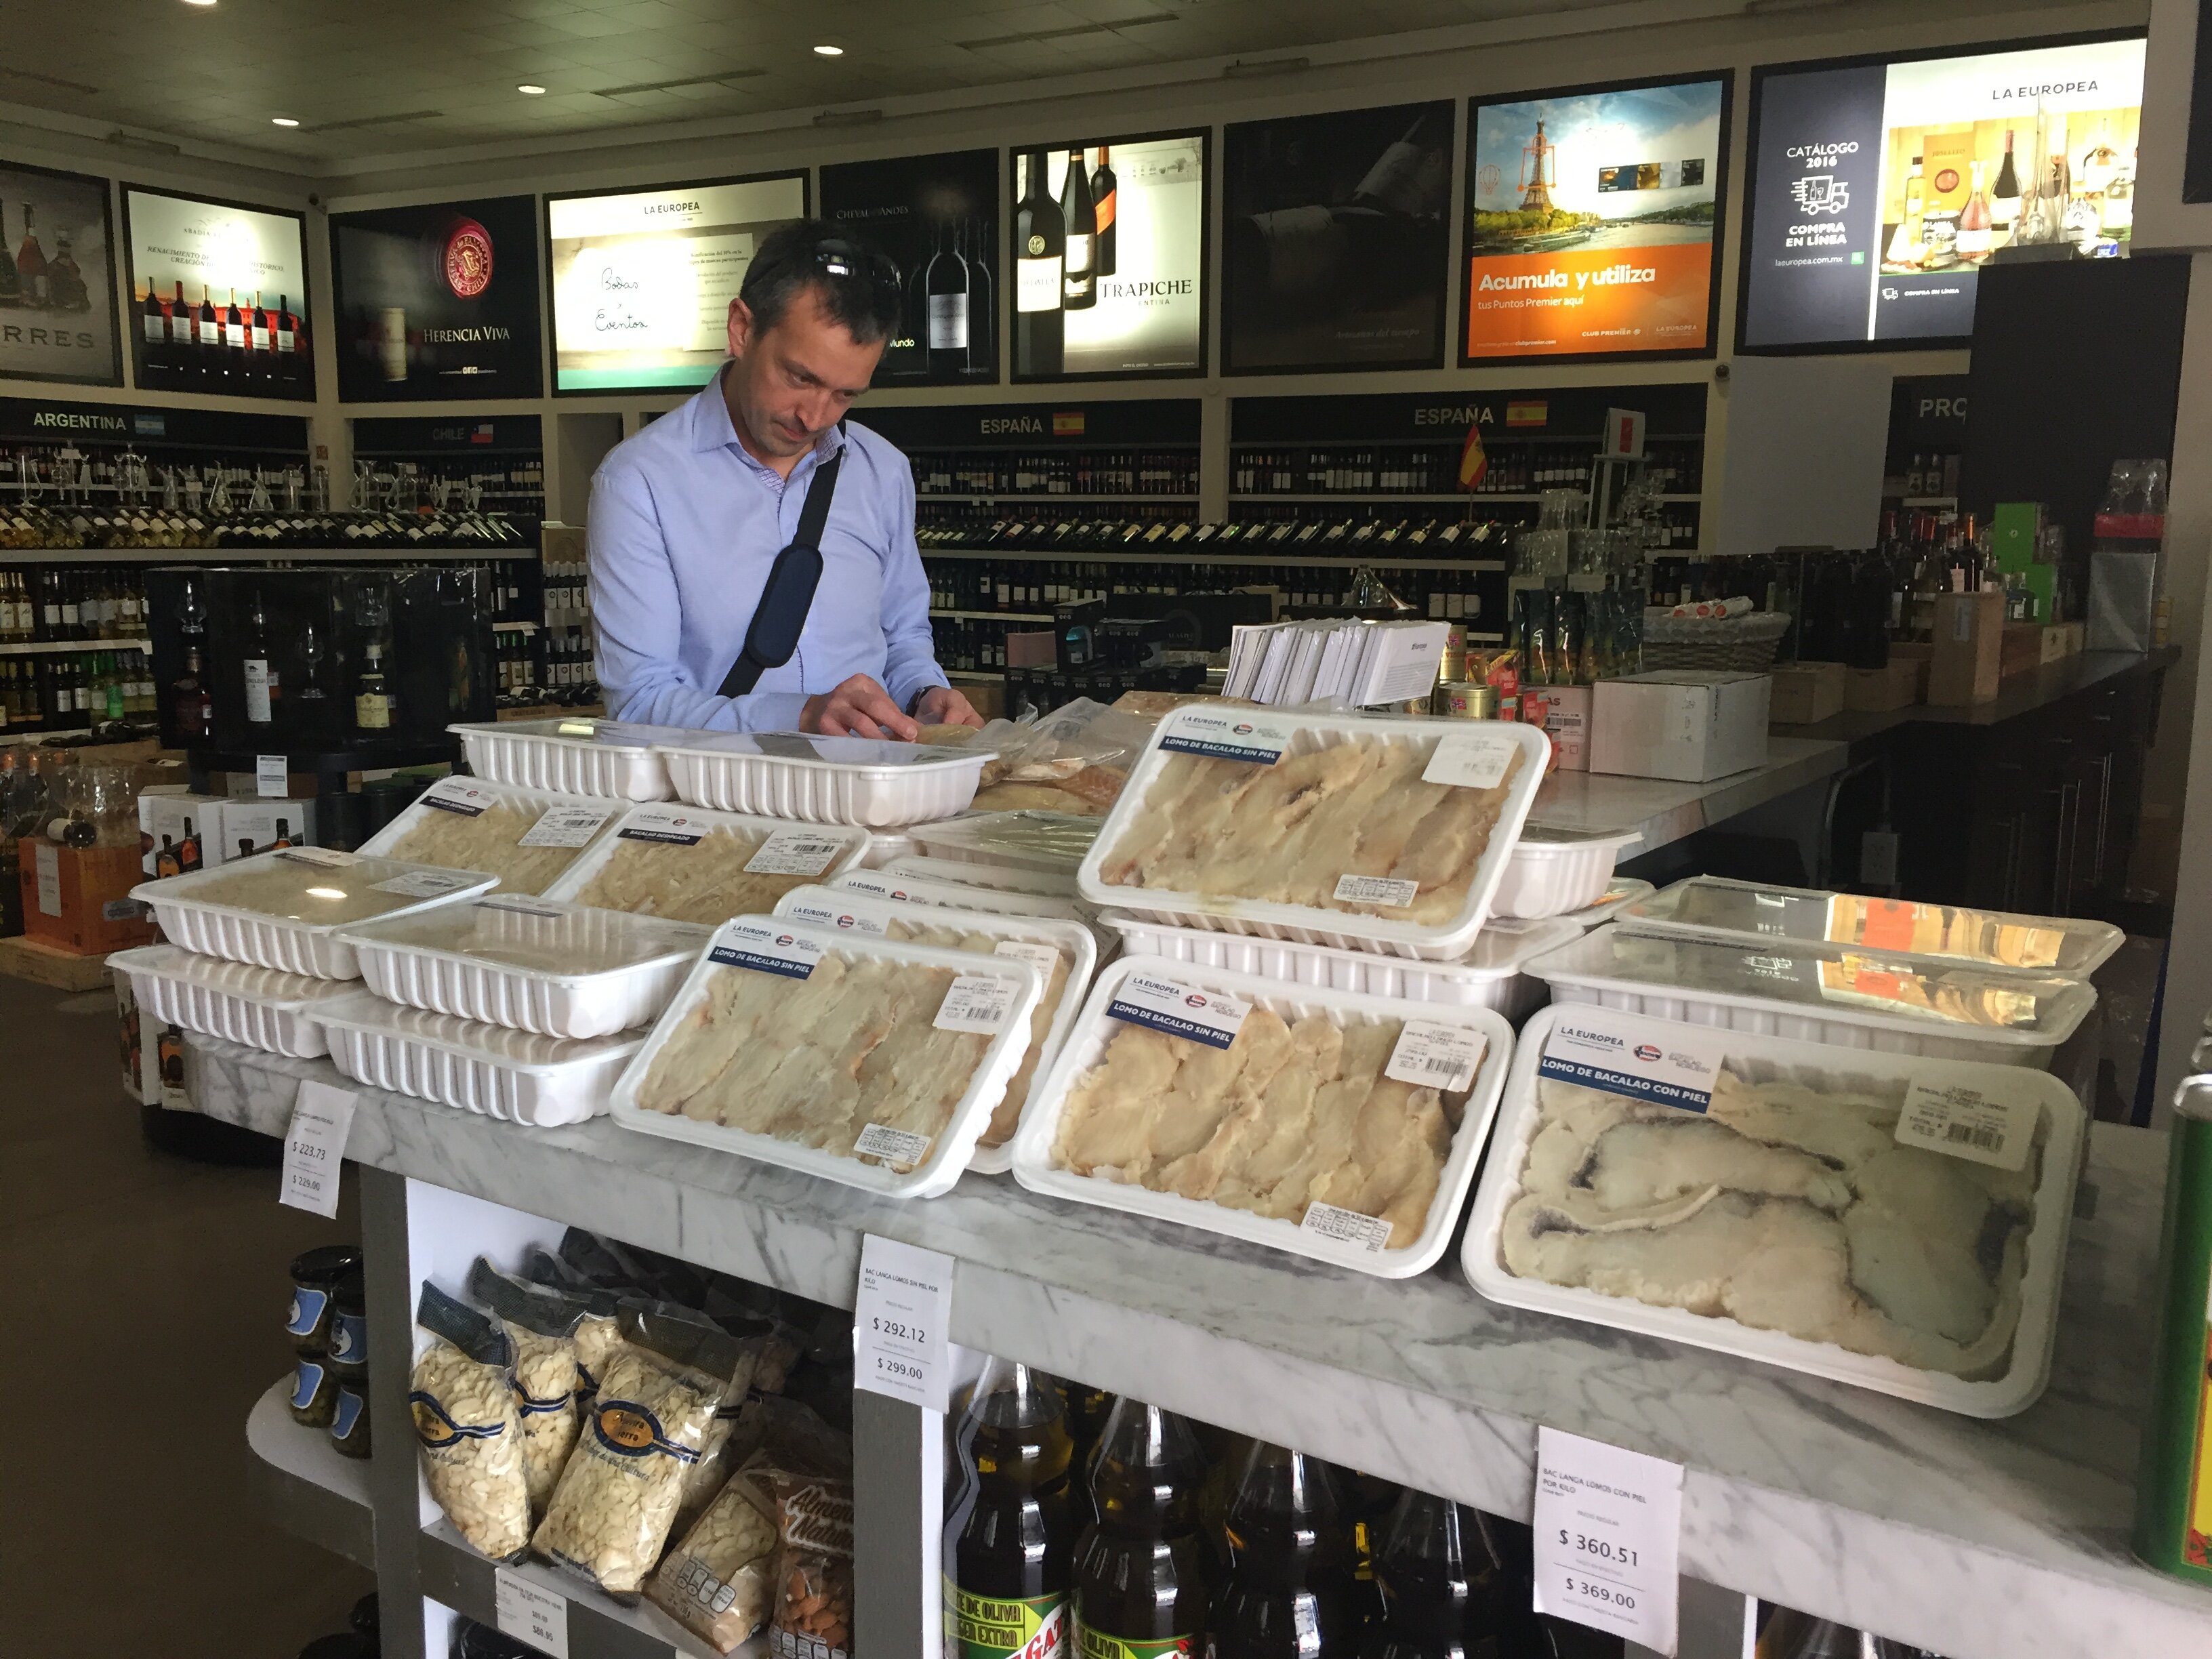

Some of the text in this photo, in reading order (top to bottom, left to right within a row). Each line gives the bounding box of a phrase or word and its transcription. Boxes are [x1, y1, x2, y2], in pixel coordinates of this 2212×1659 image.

[1992, 80, 2099, 100] LA EUROPEA
[1786, 142, 1860, 158] CATÁLOGO
[1805, 155, 1838, 169] 2016
[644, 201, 700, 215] LA EUROPEA
[836, 206, 909, 220] CHEVAL ANDES
[1788, 222, 1846, 236] COMPRA
[1786, 232, 1847, 247] EN LÍNEA
[147, 246, 201, 260] RENACIMIENTO
[1775, 255, 1843, 267] laeuropea.com.mx
[601, 267, 638, 290] Bodas
[1478, 264, 1656, 291] Acumula y utiliza
[1100, 279, 1193, 298] TRAPICHE
[1477, 294, 1585, 310] tus Puntos Premier aquí
[595, 308, 649, 331] Eventos
[423, 327, 510, 343] HERENCIA VIVA
[33, 412, 127, 431] ARGENTINA
[980, 415, 1043, 434] ESPAÑA
[1414, 405, 1494, 426] ESPAÑA
[433, 428, 465, 441] CHILE
[1193, 716, 1227, 727] EUROPEA
[1164, 737, 1277, 760] LOMO DE BACALAO SIN PIEL
[857, 882, 886, 894] EUROPEA
[803, 908, 832, 919] EUROPEA
[742, 926, 772, 937] EUROPEA
[715, 949, 737, 959] LOMO
[746, 955, 781, 967] BACALAO
[780, 962, 795, 970] SIN
[794, 964, 810, 973] PIEL
[1133, 977, 1180, 996] LA EUROPEA
[1113, 1003, 1231, 1042] LOMO DE BACALAO SIN PIEL
[1561, 1026, 1574, 1036] LA
[1576, 1029, 1624, 1047] EUROPEA
[1542, 1059, 1708, 1104] LOMO DE BACALAO CON PIEL
[293, 1141, 326, 1160] $ 223.73
[292, 1174, 321, 1191] $ 229.00
[865, 1267, 875, 1275] BAC
[892, 1275, 909, 1285] LOMOS
[873, 1317, 925, 1343] $ 292.12
[878, 1357, 922, 1380] $ 299.00
[1542, 1477, 1557, 1488] POR
[1542, 1468, 1558, 1478] BAC
[1585, 1480, 1612, 1494] LOMOS
[1613, 1488, 1631, 1499] CON
[1631, 1492, 1647, 1504] PIEL
[1559, 1529, 1638, 1567] $ 360.51
[1566, 1577, 1635, 1610] $ 369.00
[966, 1595, 1021, 1622] DE OLIVA
[977, 1624, 1018, 1648] EXTRA
